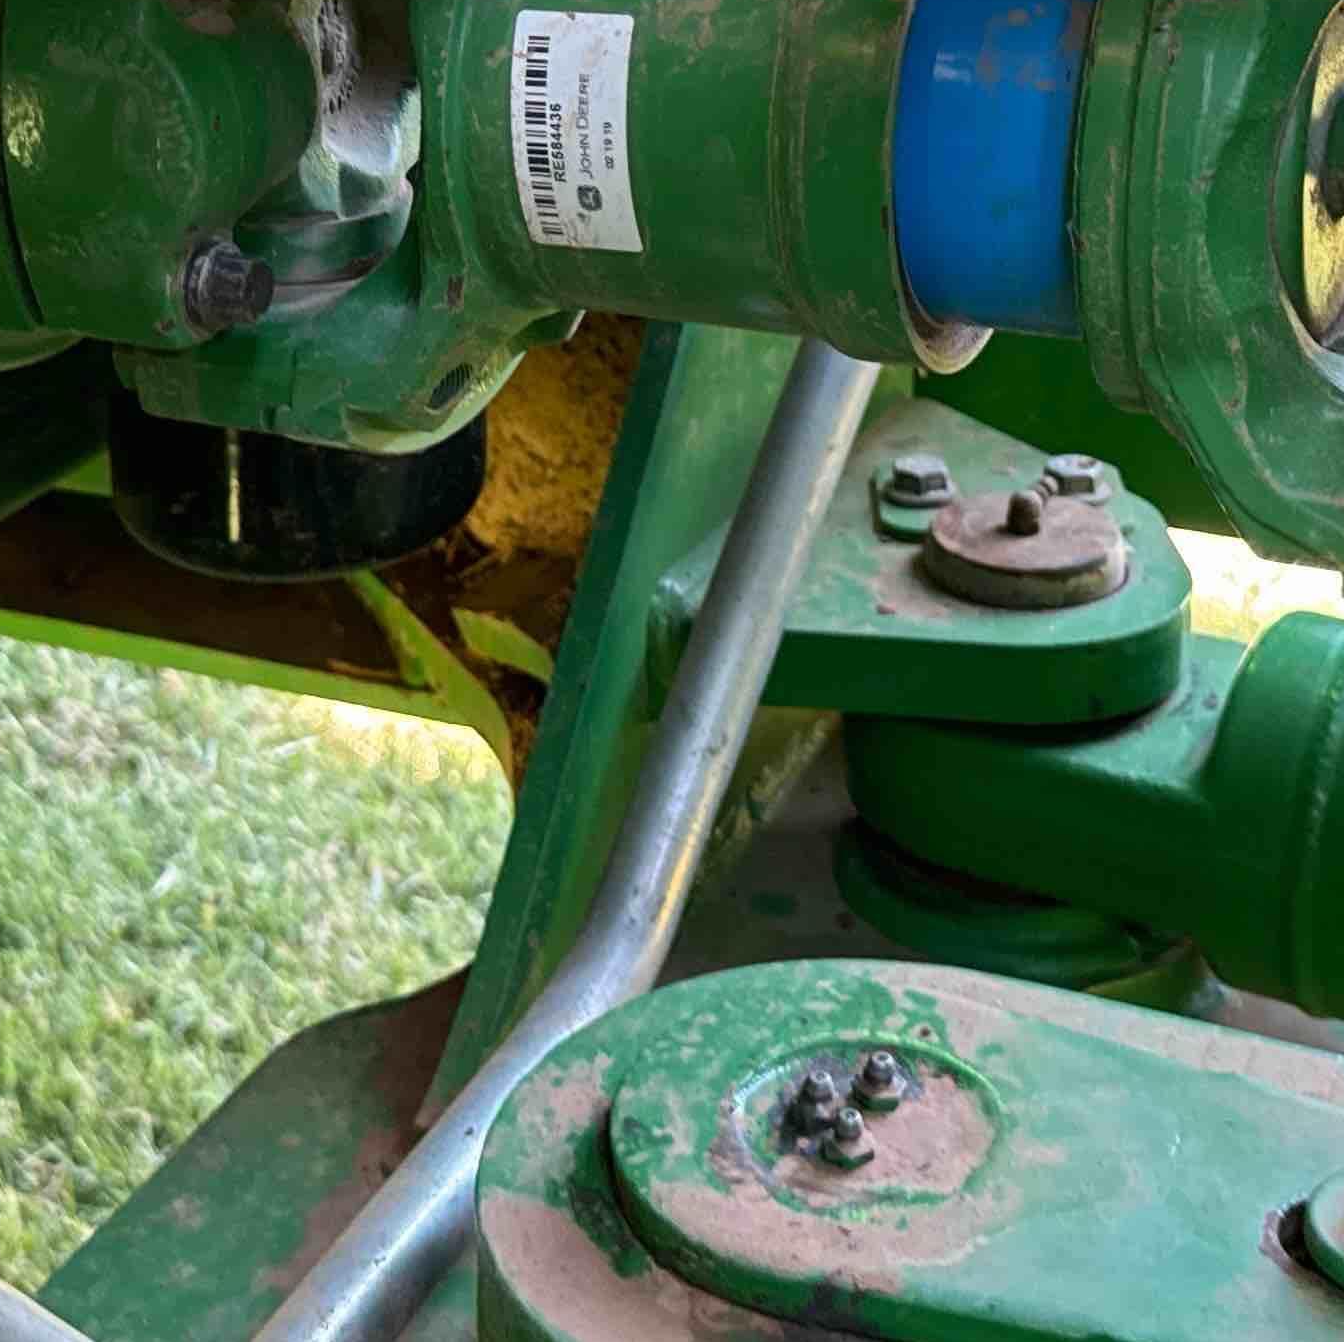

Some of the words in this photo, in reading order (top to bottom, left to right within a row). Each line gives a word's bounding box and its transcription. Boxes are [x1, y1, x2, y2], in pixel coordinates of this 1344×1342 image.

[575, 73, 591, 130] DEERE
[549, 103, 567, 183] RE584436
[577, 132, 595, 179] JOHN
